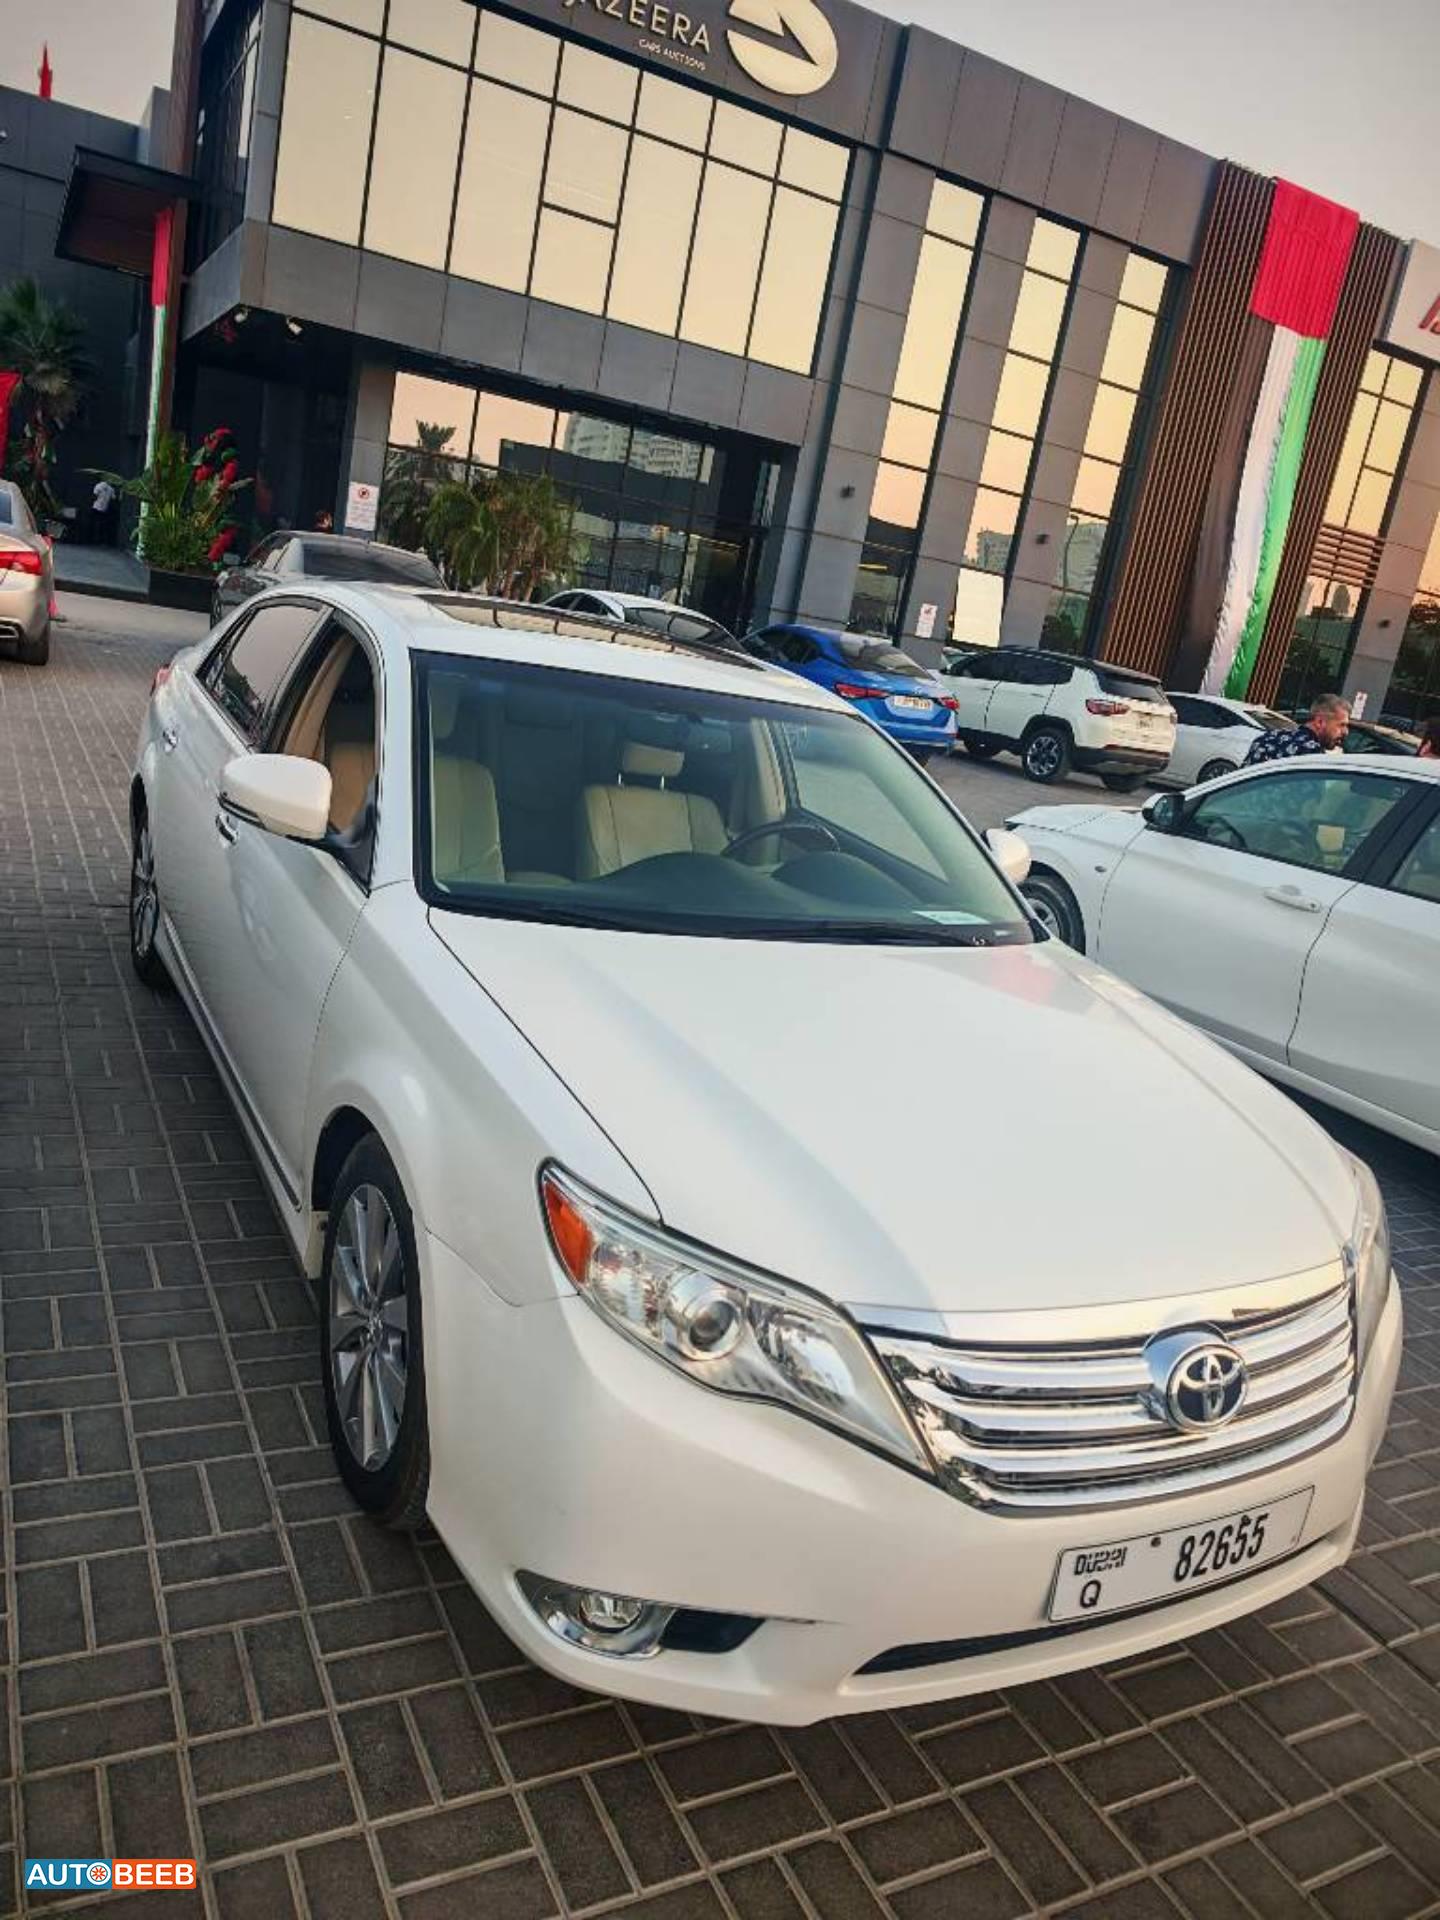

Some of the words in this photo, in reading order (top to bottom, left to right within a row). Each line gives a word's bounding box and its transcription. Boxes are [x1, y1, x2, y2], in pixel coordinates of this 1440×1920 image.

[563, 0, 710, 53] ZEERA
[1174, 1513, 1270, 1583] 82655
[1080, 1579, 1101, 1609] Q
